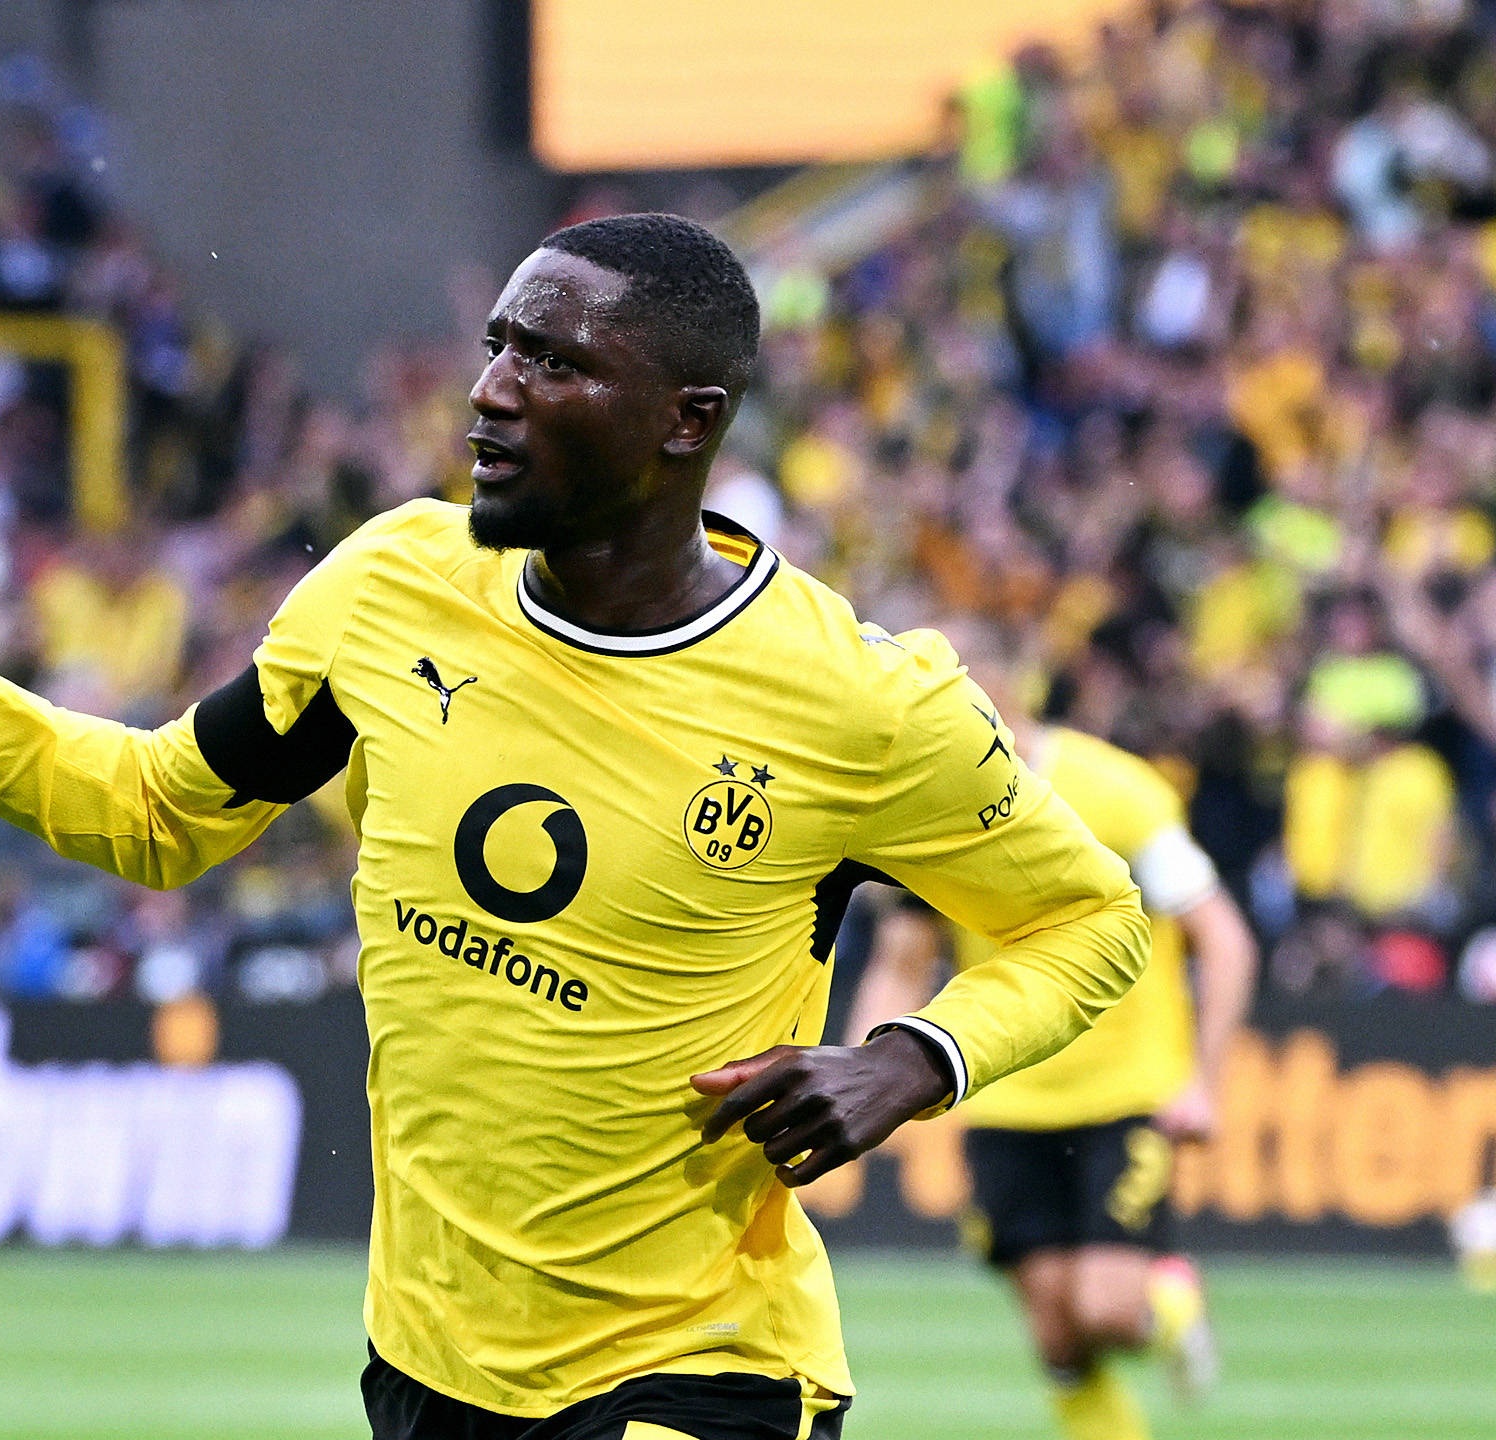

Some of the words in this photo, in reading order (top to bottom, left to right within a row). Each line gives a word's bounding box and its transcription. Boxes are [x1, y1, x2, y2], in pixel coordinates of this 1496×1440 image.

[693, 787, 765, 851] BVB
[706, 839, 732, 862] 09
[394, 898, 588, 1012] vodafone
